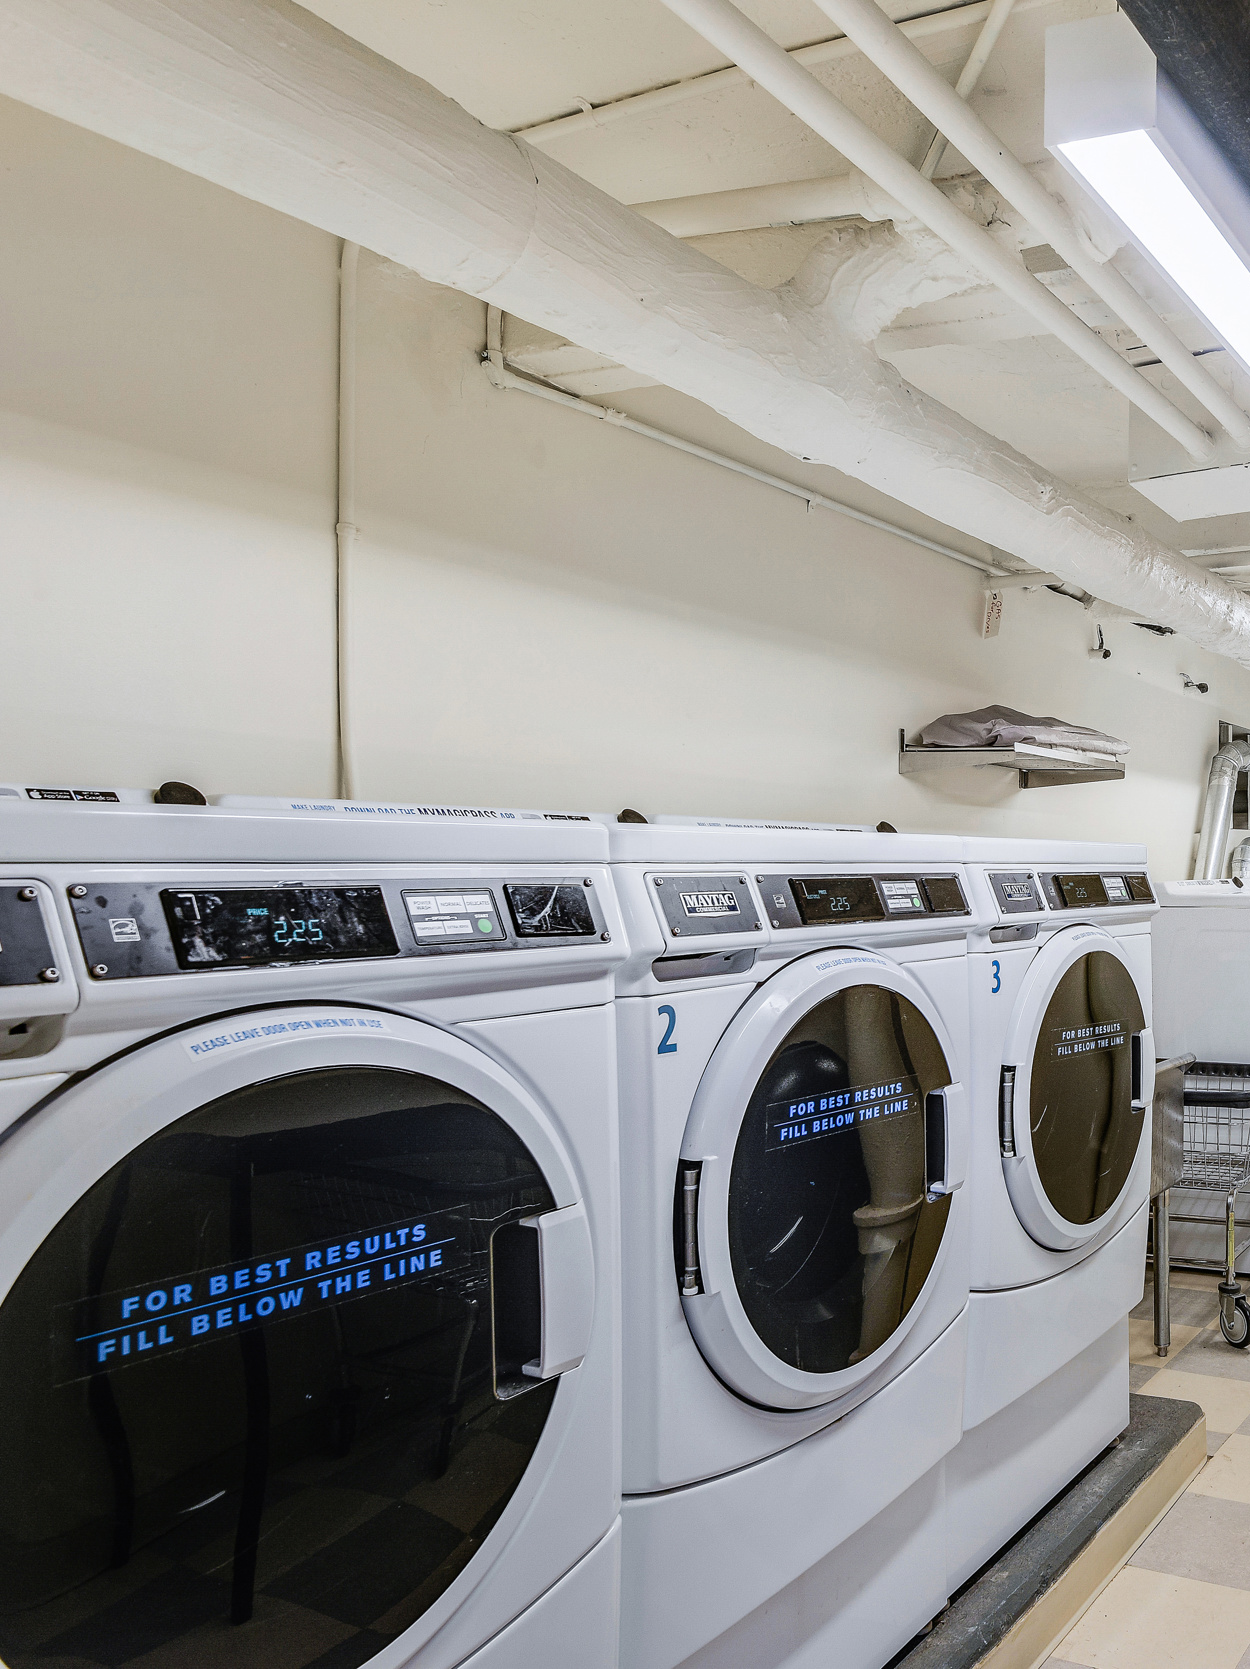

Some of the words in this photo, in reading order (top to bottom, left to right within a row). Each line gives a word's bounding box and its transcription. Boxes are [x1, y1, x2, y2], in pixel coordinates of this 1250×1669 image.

[684, 894, 735, 907] MAYTAG
[816, 962, 832, 971] PLEASE
[831, 958, 844, 967] LEAVE
[992, 960, 1001, 993] 3
[190, 1036, 231, 1054] PLEASE
[230, 1028, 262, 1043] LEAVE
[260, 1024, 289, 1036] DOOR
[288, 1020, 313, 1032] OPEN
[311, 1019, 339, 1028] WHEN
[338, 1019, 355, 1027] NOT
[355, 1019, 367, 1027] IN
[366, 1019, 384, 1029] USE
[658, 1004, 678, 1054] 2
[1057, 1046, 1072, 1056] FILL
[1074, 1040, 1096, 1053] BELOW
[1098, 1038, 1109, 1048] THE
[1111, 1036, 1124, 1046] LINE
[1062, 1030, 1076, 1040] FOR
[1078, 1027, 1094, 1038] BEST
[1095, 1023, 1121, 1035] RESULTS
[789, 1102, 815, 1118] FOR
[820, 1094, 850, 1111] BEST
[854, 1082, 902, 1103] RESULTS
[780, 1124, 808, 1141] FILL
[812, 1112, 854, 1132] BELOW
[859, 1106, 880, 1122] THE
[884, 1099, 908, 1115] LINE
[121, 1283, 193, 1319] FOR
[209, 1257, 292, 1296] BEST
[304, 1223, 427, 1272] RESULTS
[97, 1324, 174, 1363] FILL
[190, 1287, 305, 1336] BELOW
[318, 1268, 372, 1300] THE
[384, 1248, 444, 1282] LINE
